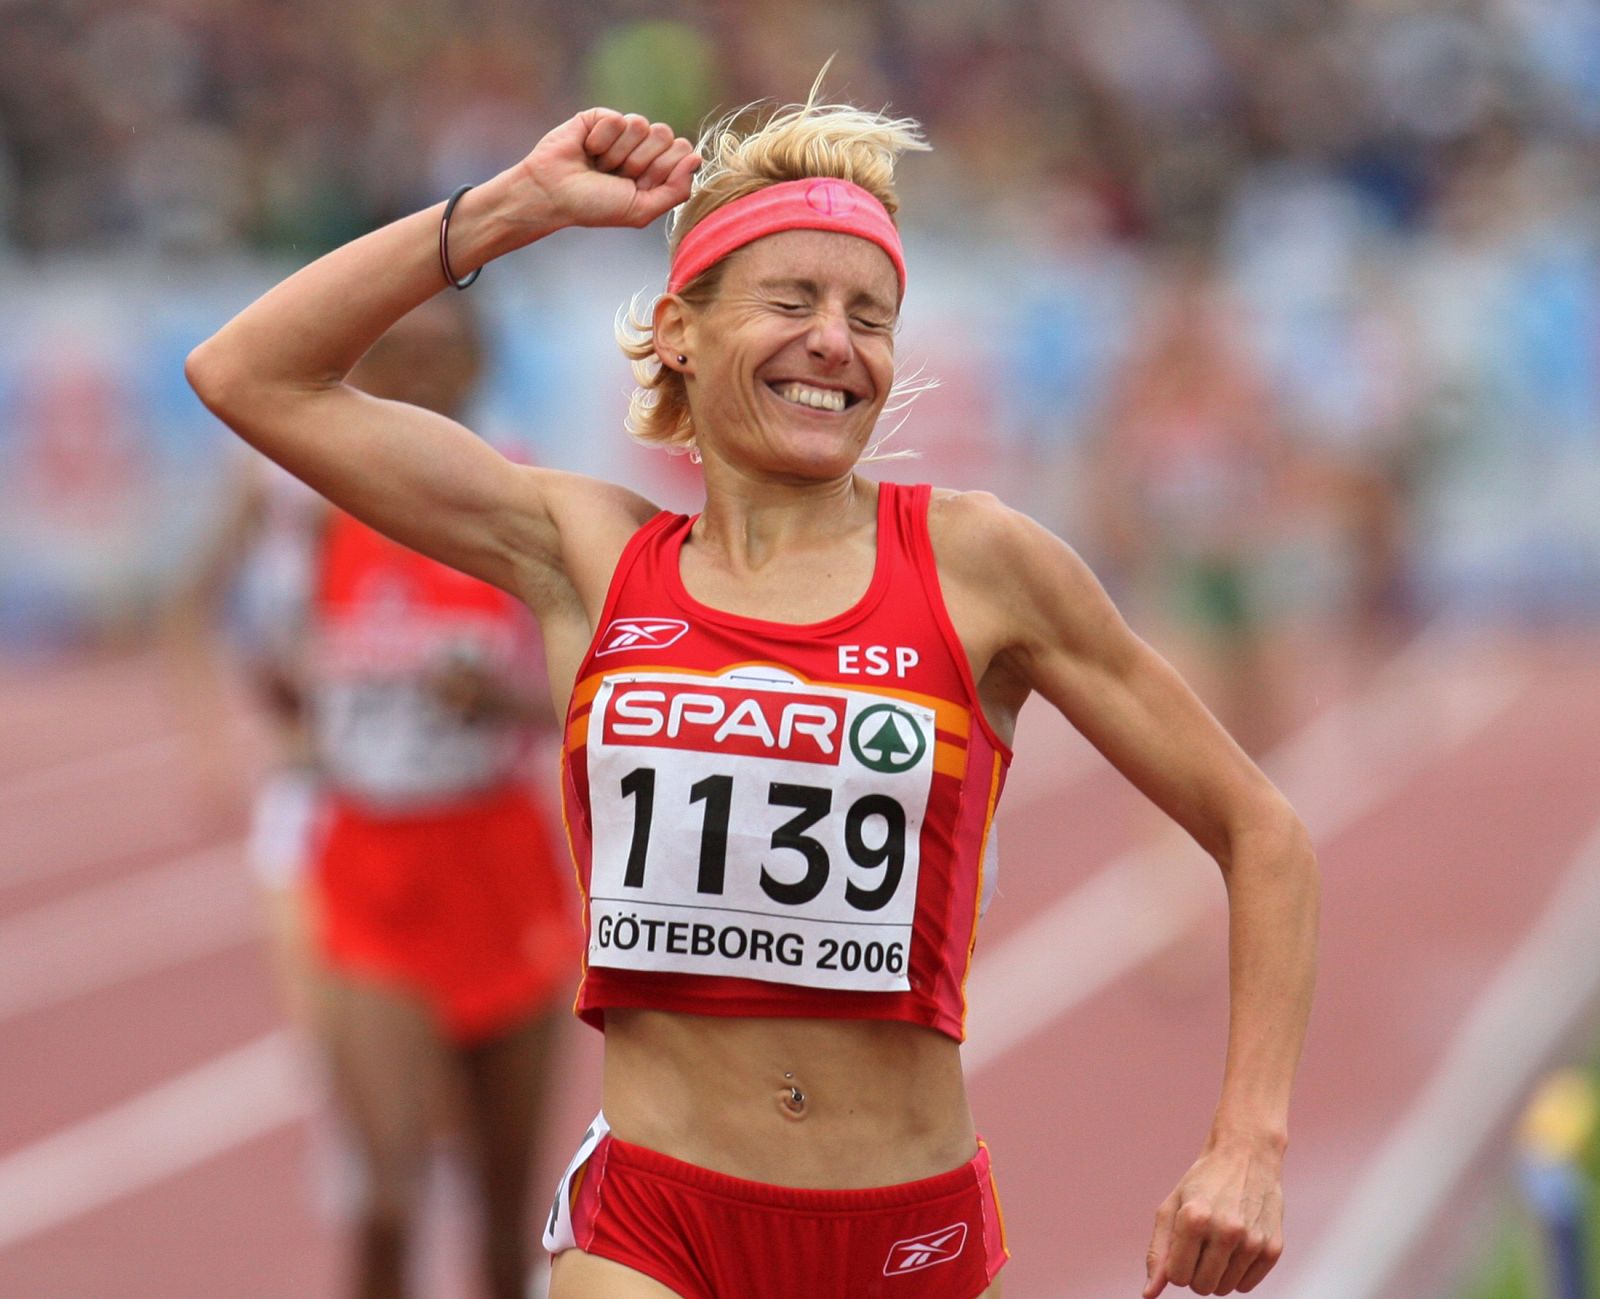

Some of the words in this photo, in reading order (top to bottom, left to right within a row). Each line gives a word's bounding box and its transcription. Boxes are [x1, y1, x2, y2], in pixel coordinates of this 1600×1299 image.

[838, 645, 919, 678] ESP
[611, 690, 838, 755] SPAR
[620, 767, 906, 911] 1139
[598, 911, 804, 967] GÖTEBORG
[816, 940, 904, 973] 2006
